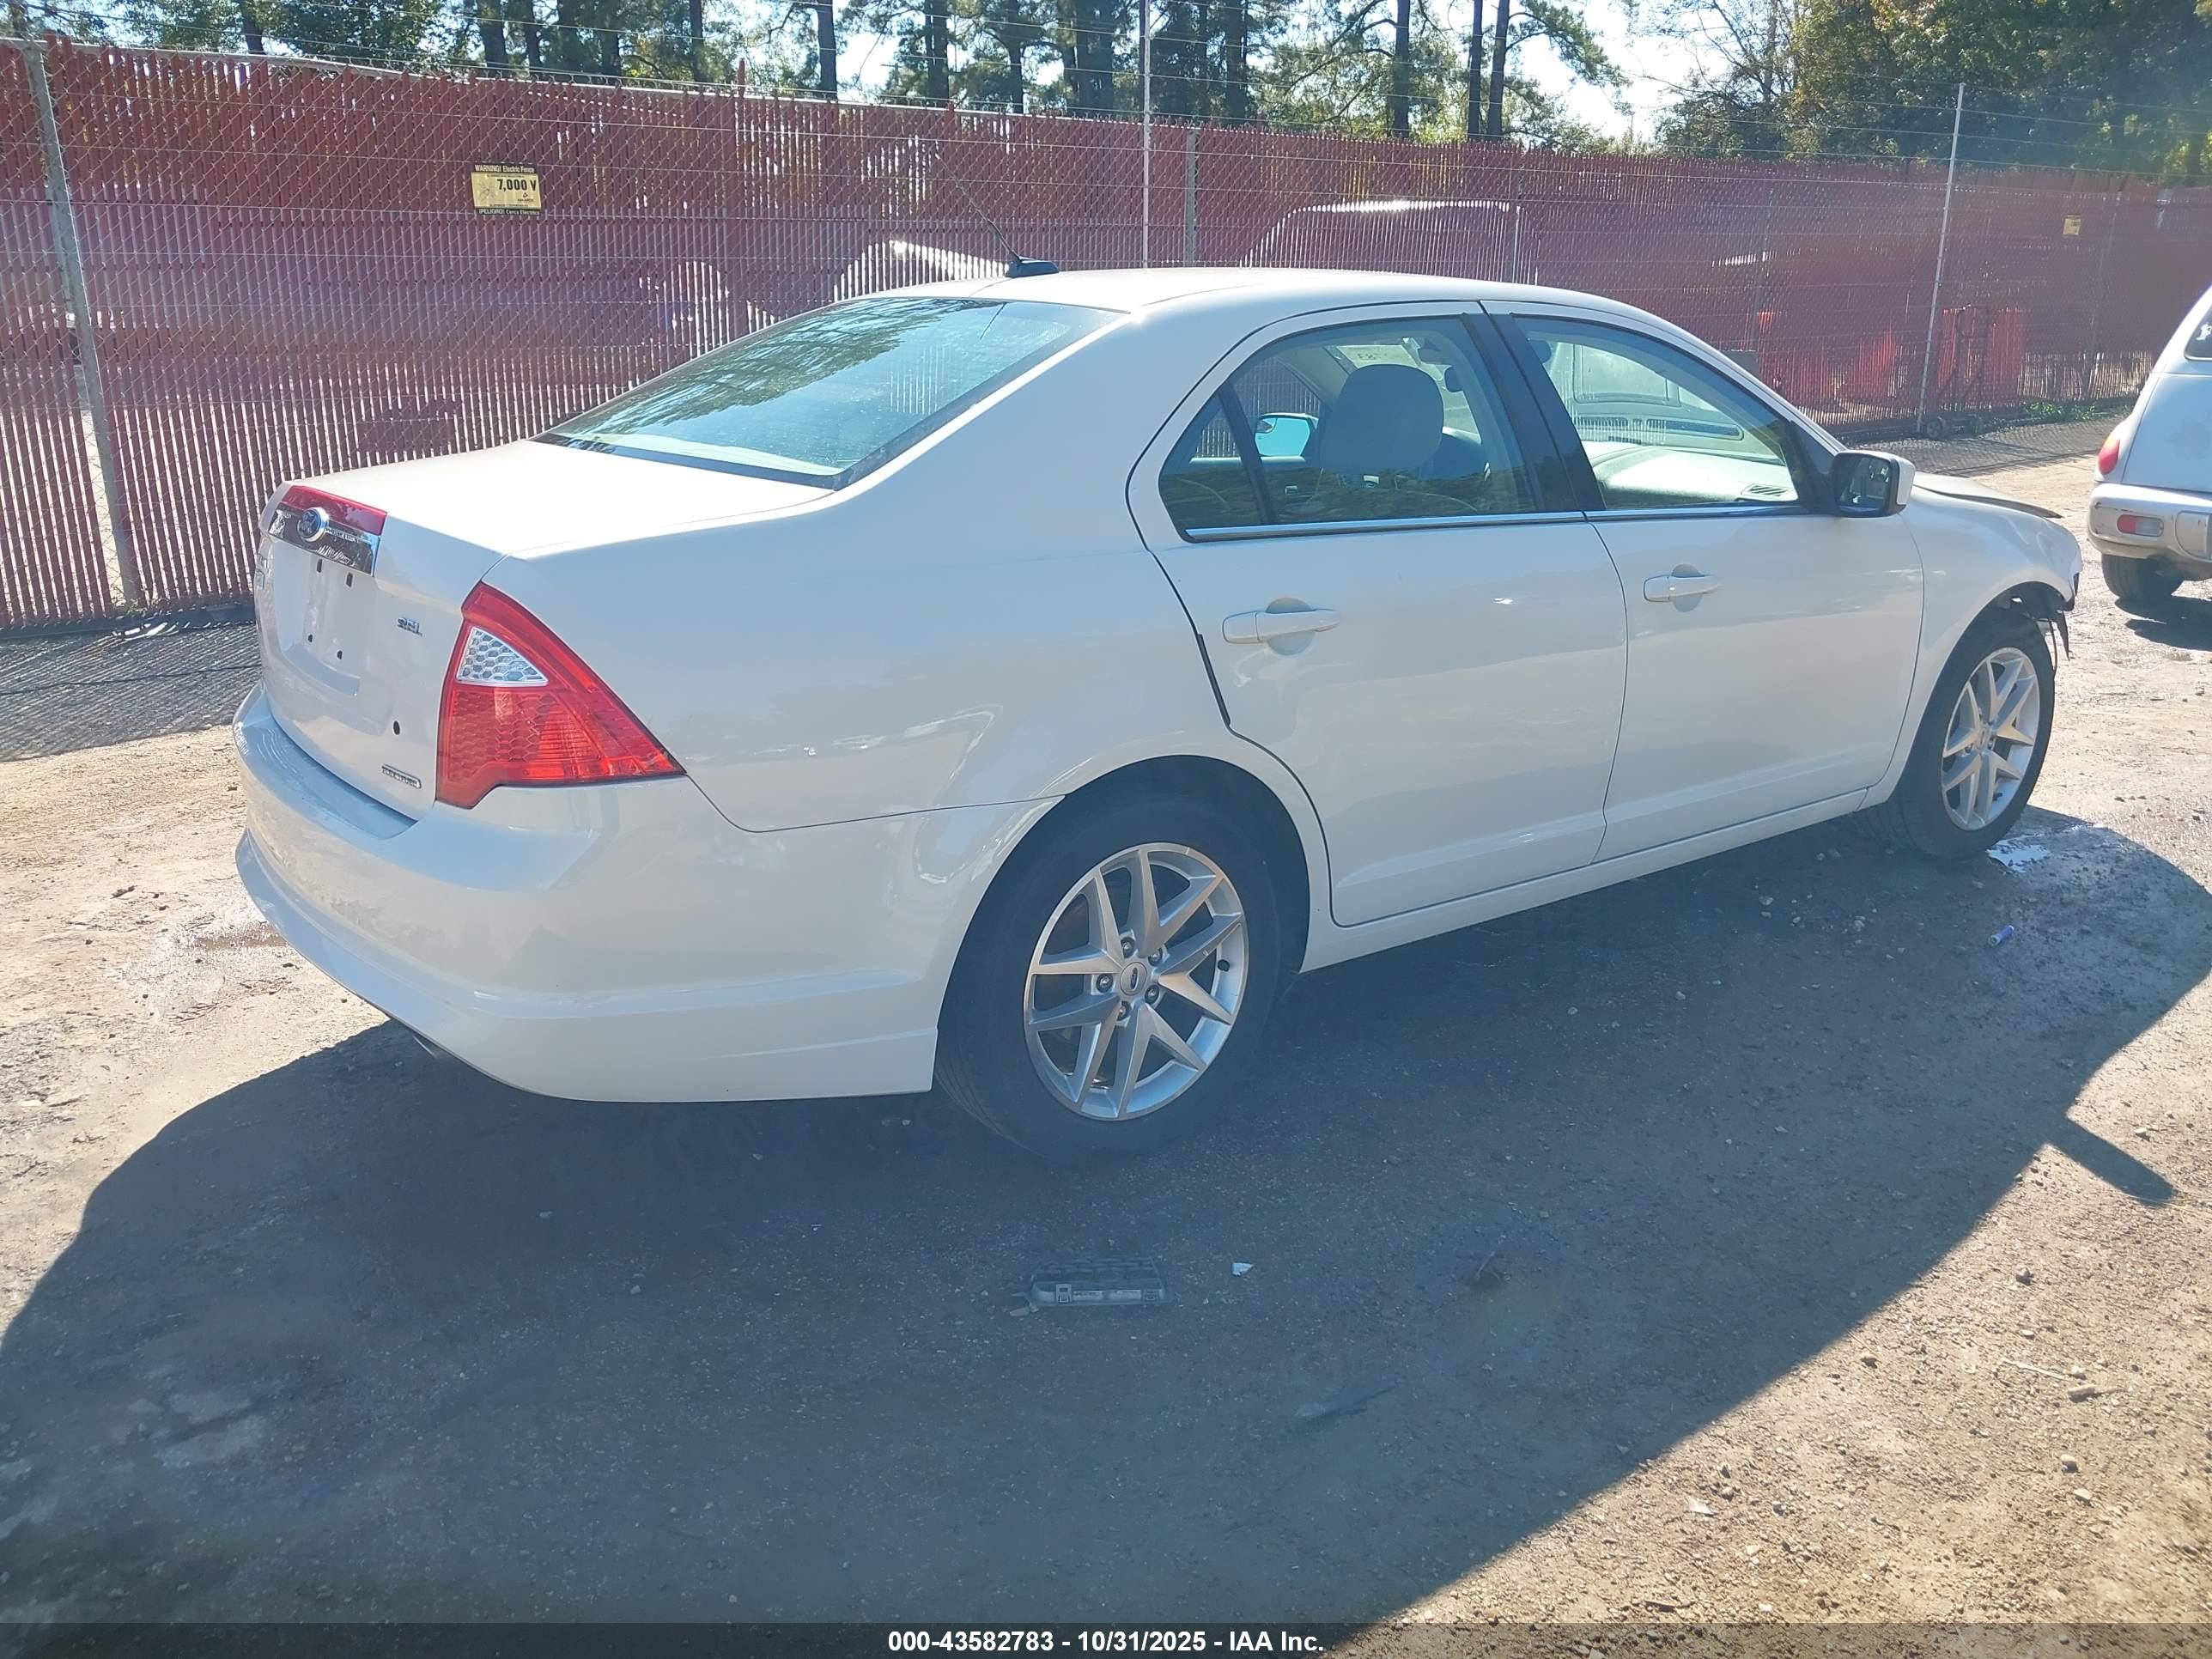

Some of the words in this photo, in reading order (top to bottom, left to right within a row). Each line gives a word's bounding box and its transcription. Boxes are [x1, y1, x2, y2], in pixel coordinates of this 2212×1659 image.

[475, 164, 501, 173] WARNING!
[497, 179, 528, 191] 7,000
[530, 179, 537, 191] V
